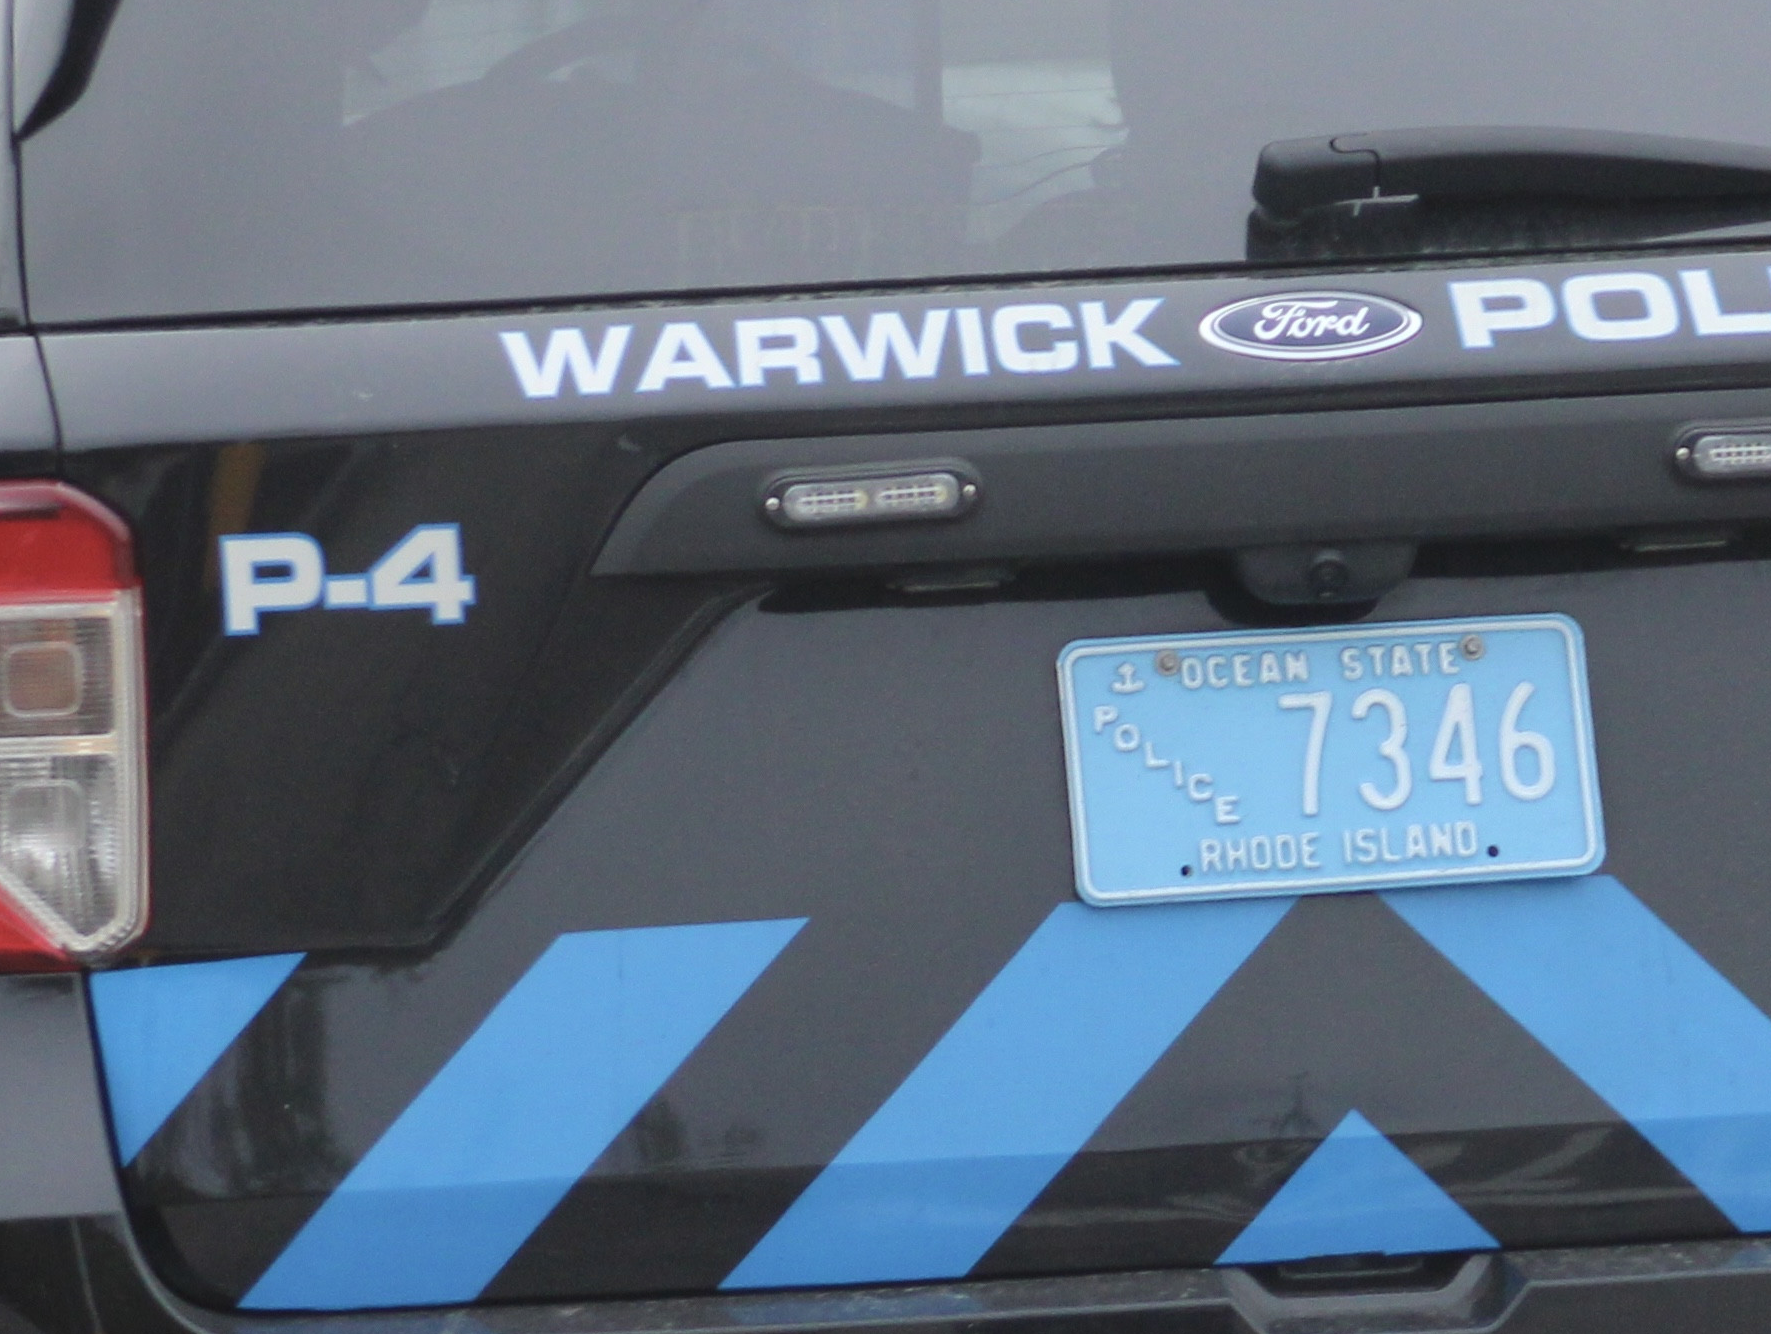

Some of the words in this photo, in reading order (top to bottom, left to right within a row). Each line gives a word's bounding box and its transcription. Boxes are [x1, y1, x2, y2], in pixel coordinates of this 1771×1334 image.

[498, 296, 1181, 398] WARWICK
[1253, 300, 1370, 341] Ford
[218, 522, 477, 637] P-4
[1179, 650, 1311, 691] OCEAN
[1340, 641, 1462, 681] STATE
[1093, 703, 1242, 825] POLICE
[1277, 679, 1557, 818] 7346
[1198, 831, 1323, 875] RHODE
[1343, 819, 1480, 864] ISLAND
